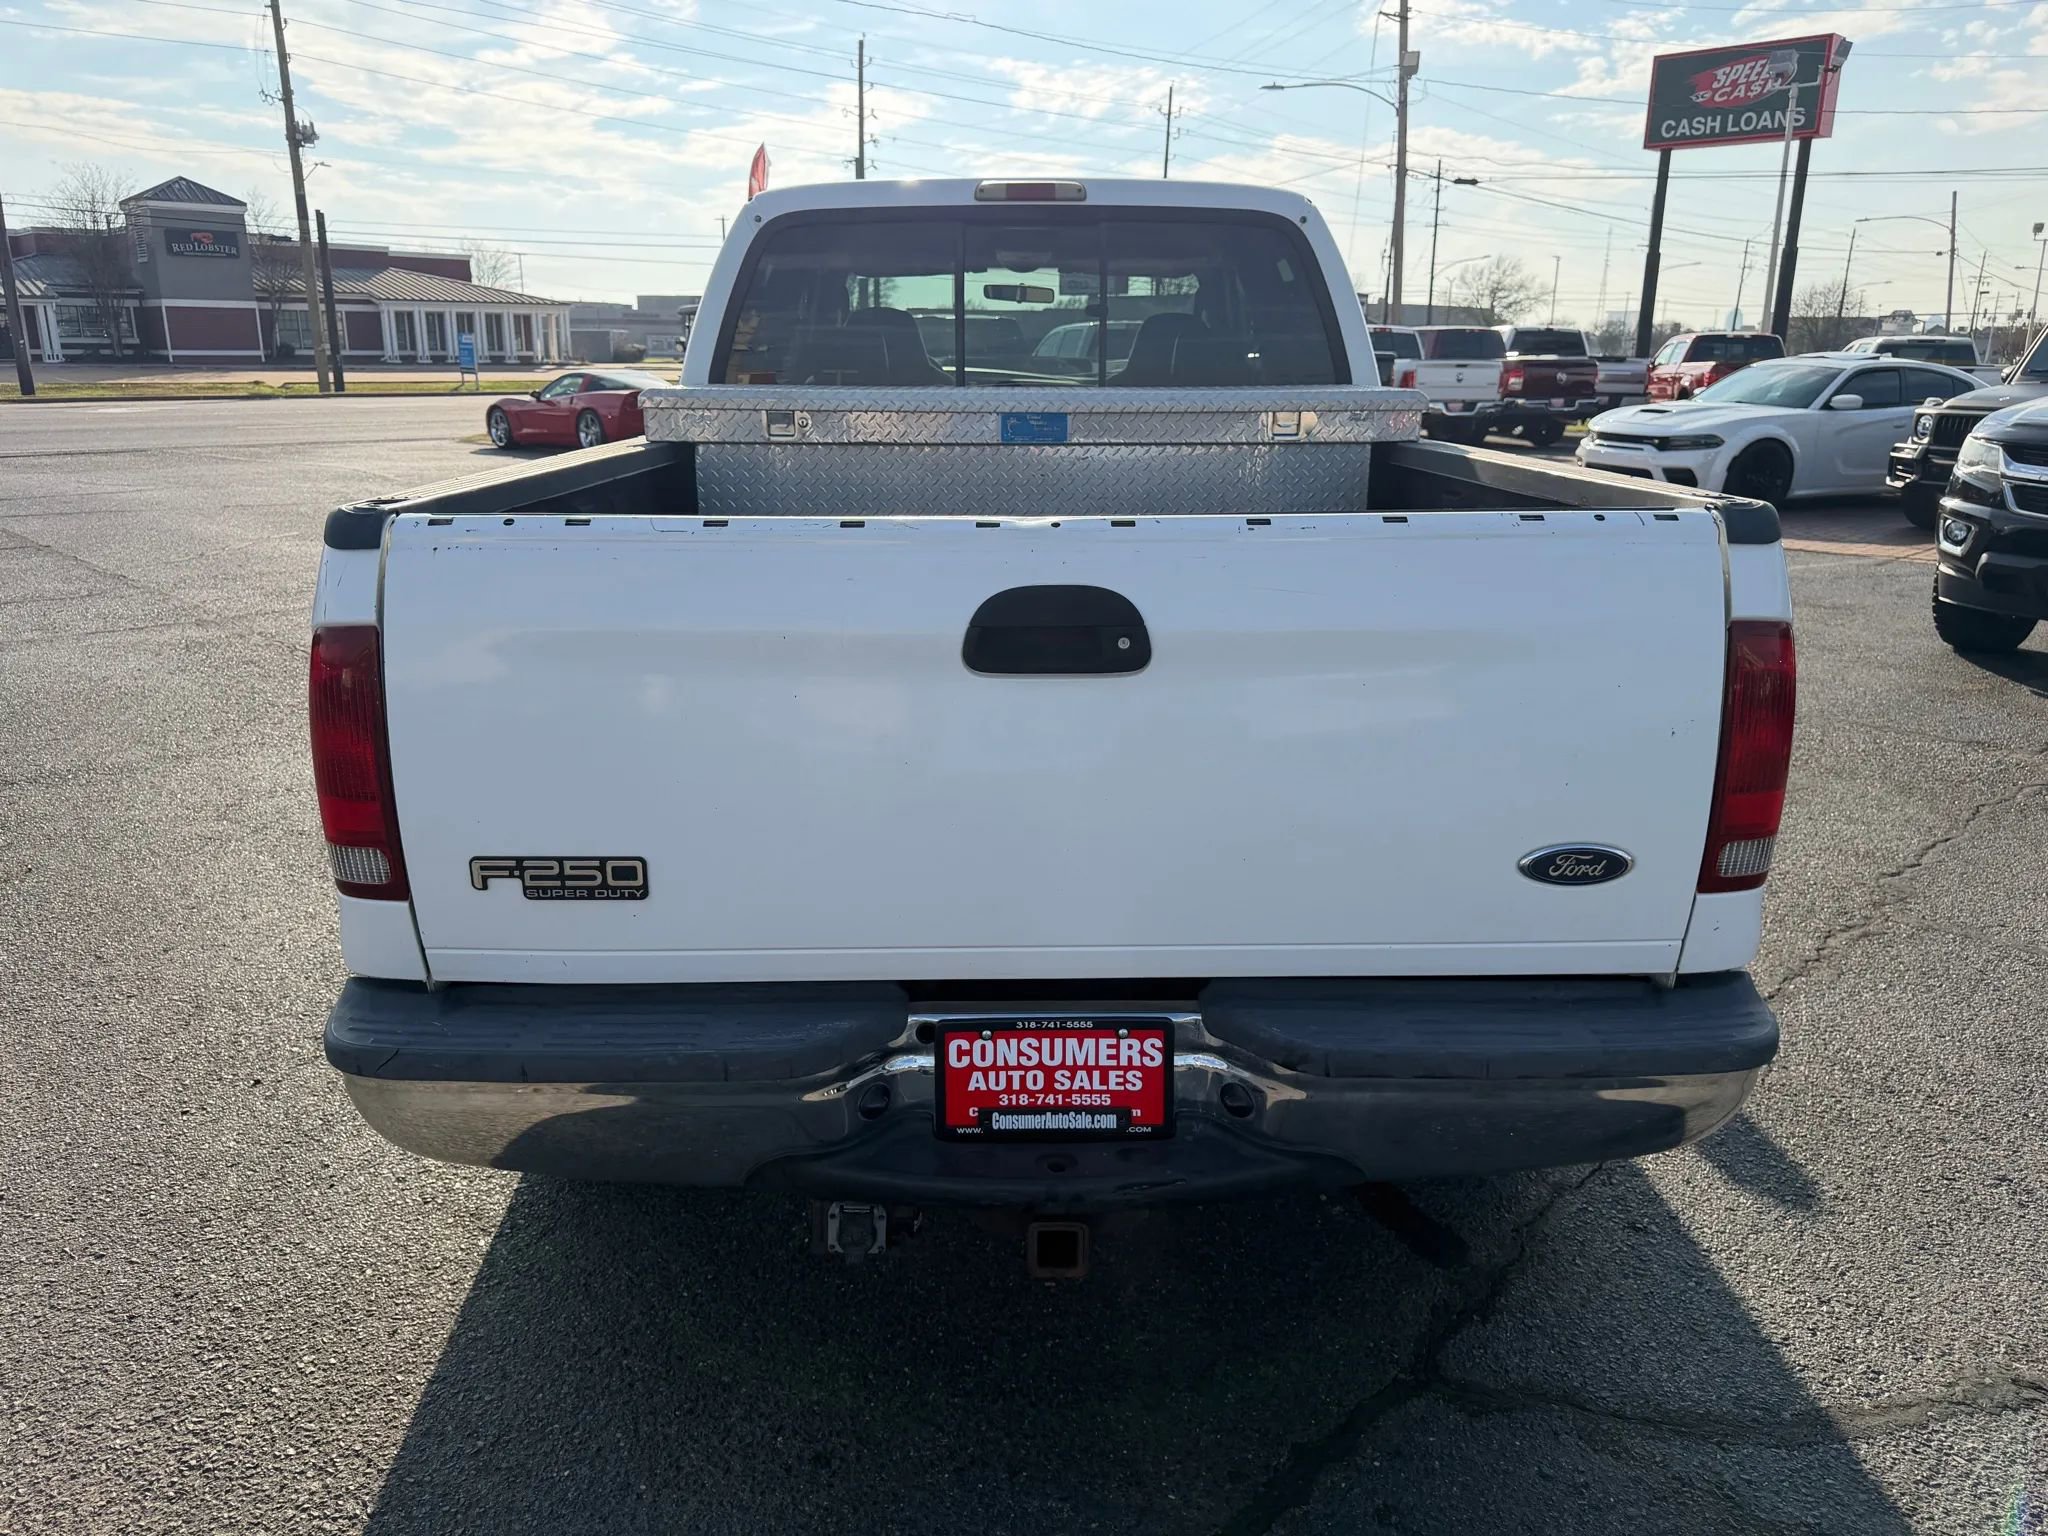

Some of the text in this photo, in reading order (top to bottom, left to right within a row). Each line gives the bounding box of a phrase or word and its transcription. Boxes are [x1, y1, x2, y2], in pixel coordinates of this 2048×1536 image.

[1661, 107, 1806, 138] CASH LOANS
[172, 243, 193, 253] RED
[194, 242, 237, 255] LOBSTER
[1548, 854, 1607, 876] Ford
[526, 889, 645, 898] SUPER DUTY
[1016, 1021, 1093, 1029] 318-741-5555
[948, 1037, 1163, 1068] CONSUMERS
[968, 1069, 1143, 1092] AUTO SALES
[998, 1094, 1112, 1106] 318-741-5555
[991, 1111, 1117, 1131] ConsumerAutoSale.com
